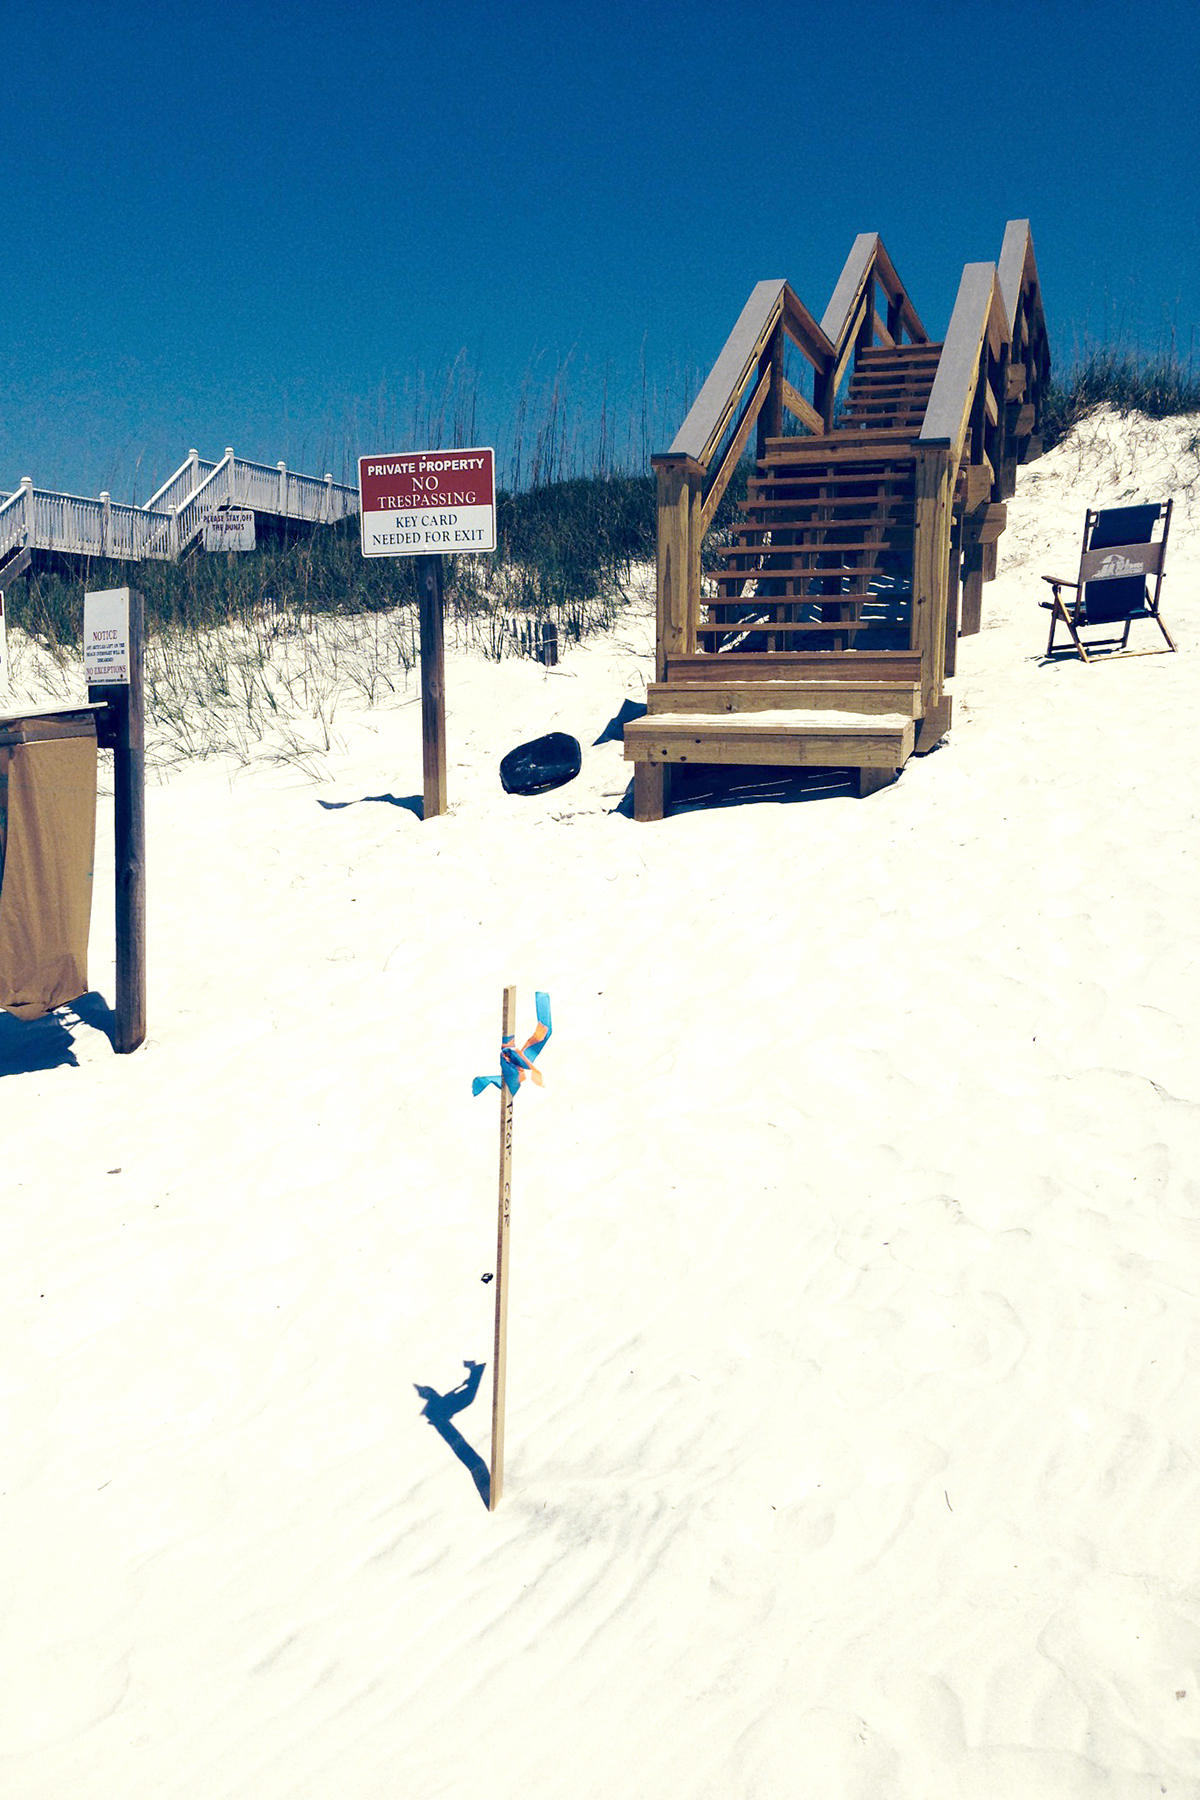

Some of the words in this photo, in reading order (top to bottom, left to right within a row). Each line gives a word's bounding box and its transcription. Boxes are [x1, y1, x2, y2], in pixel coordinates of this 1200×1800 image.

[367, 462, 416, 476] PRIVATE
[419, 458, 485, 472] PROPERTY
[411, 475, 439, 491] NO
[377, 491, 476, 509] TRESPASSING
[395, 516, 418, 528] KEY
[421, 514, 458, 527] CARD
[372, 532, 421, 545] NEEDED
[425, 530, 451, 543] FOR
[455, 529, 485, 541] EXIT
[93, 630, 117, 641] NOTICE
[94, 664, 127, 675] EXCEPTIONS
